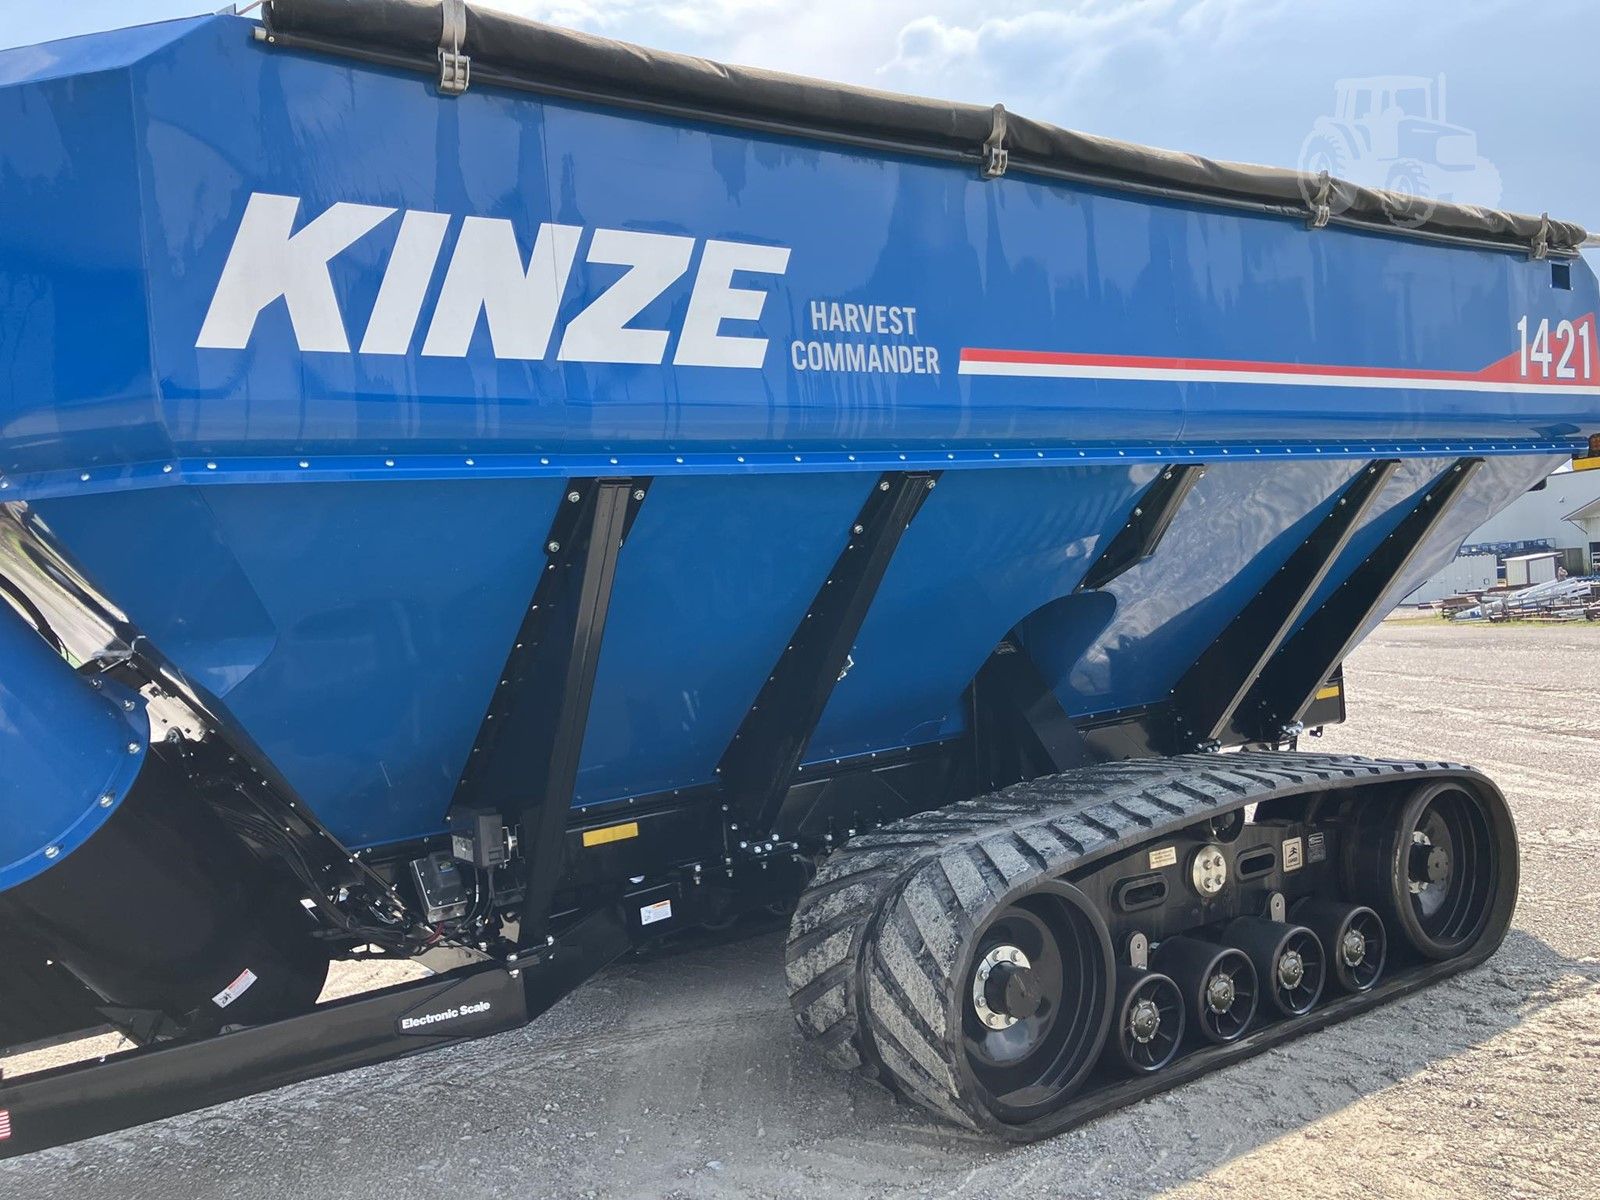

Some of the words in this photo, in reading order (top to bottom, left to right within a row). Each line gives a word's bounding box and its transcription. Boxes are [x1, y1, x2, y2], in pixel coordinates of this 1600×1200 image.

[195, 191, 792, 369] KINZE
[810, 300, 916, 335] HARVEST
[790, 340, 941, 375] COMMANDER
[1517, 315, 1591, 379] 1421
[402, 1009, 459, 1029] Electronic
[459, 1001, 491, 1016] Scale
